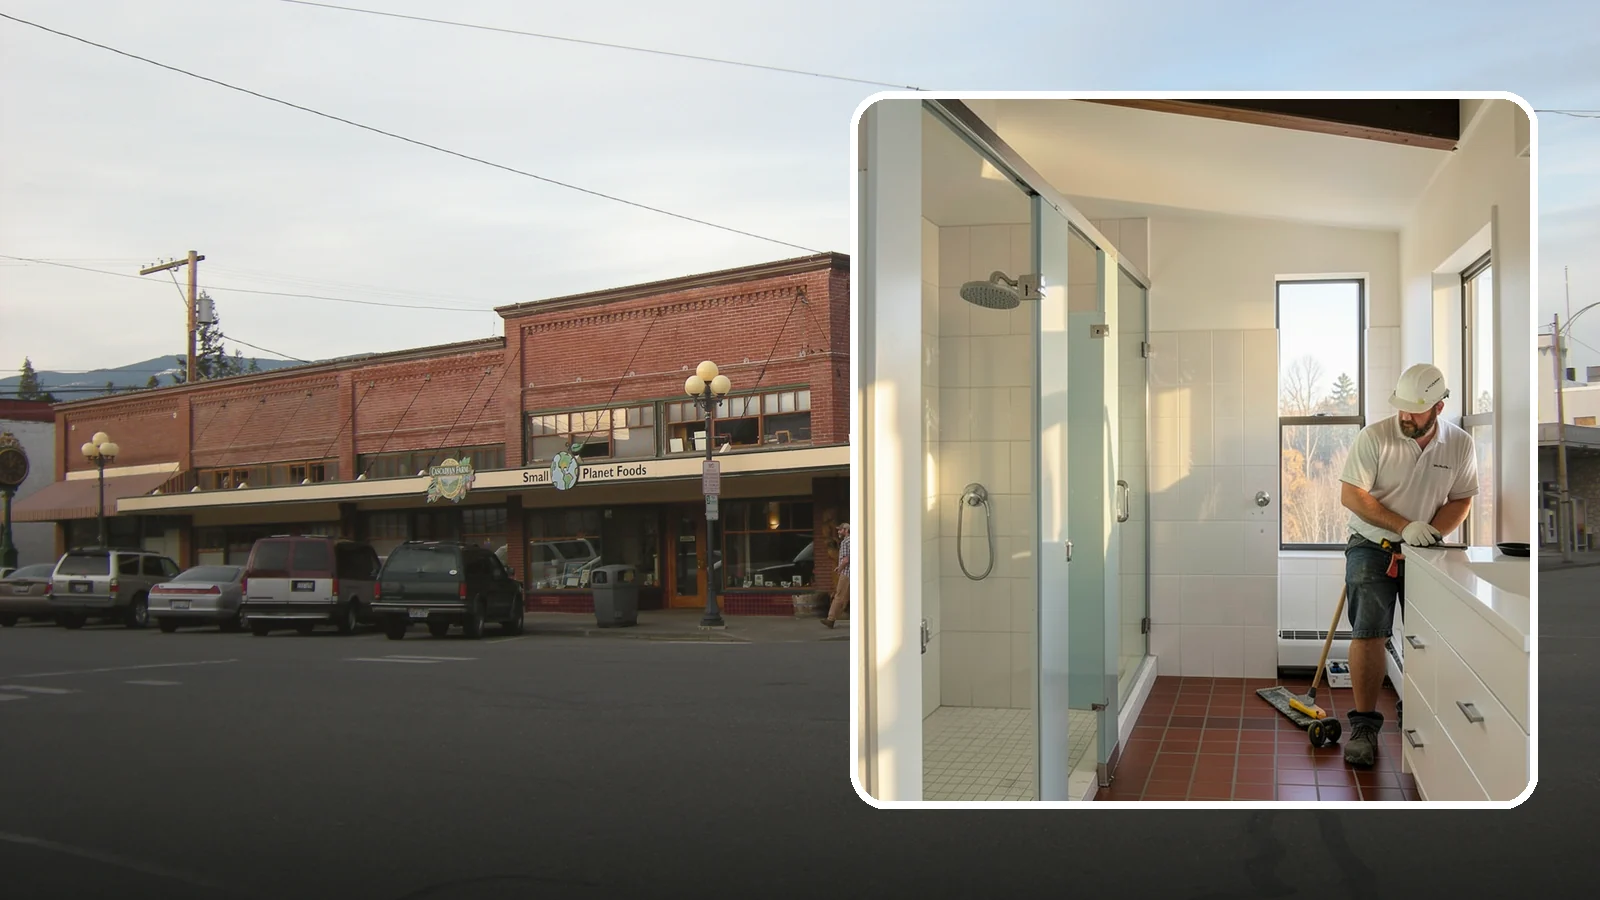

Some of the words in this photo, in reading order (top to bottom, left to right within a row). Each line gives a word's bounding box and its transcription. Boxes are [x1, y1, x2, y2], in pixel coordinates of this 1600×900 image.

[523, 471, 549, 483] Small
[583, 467, 614, 479] Planet
[617, 464, 647, 477] Foods
